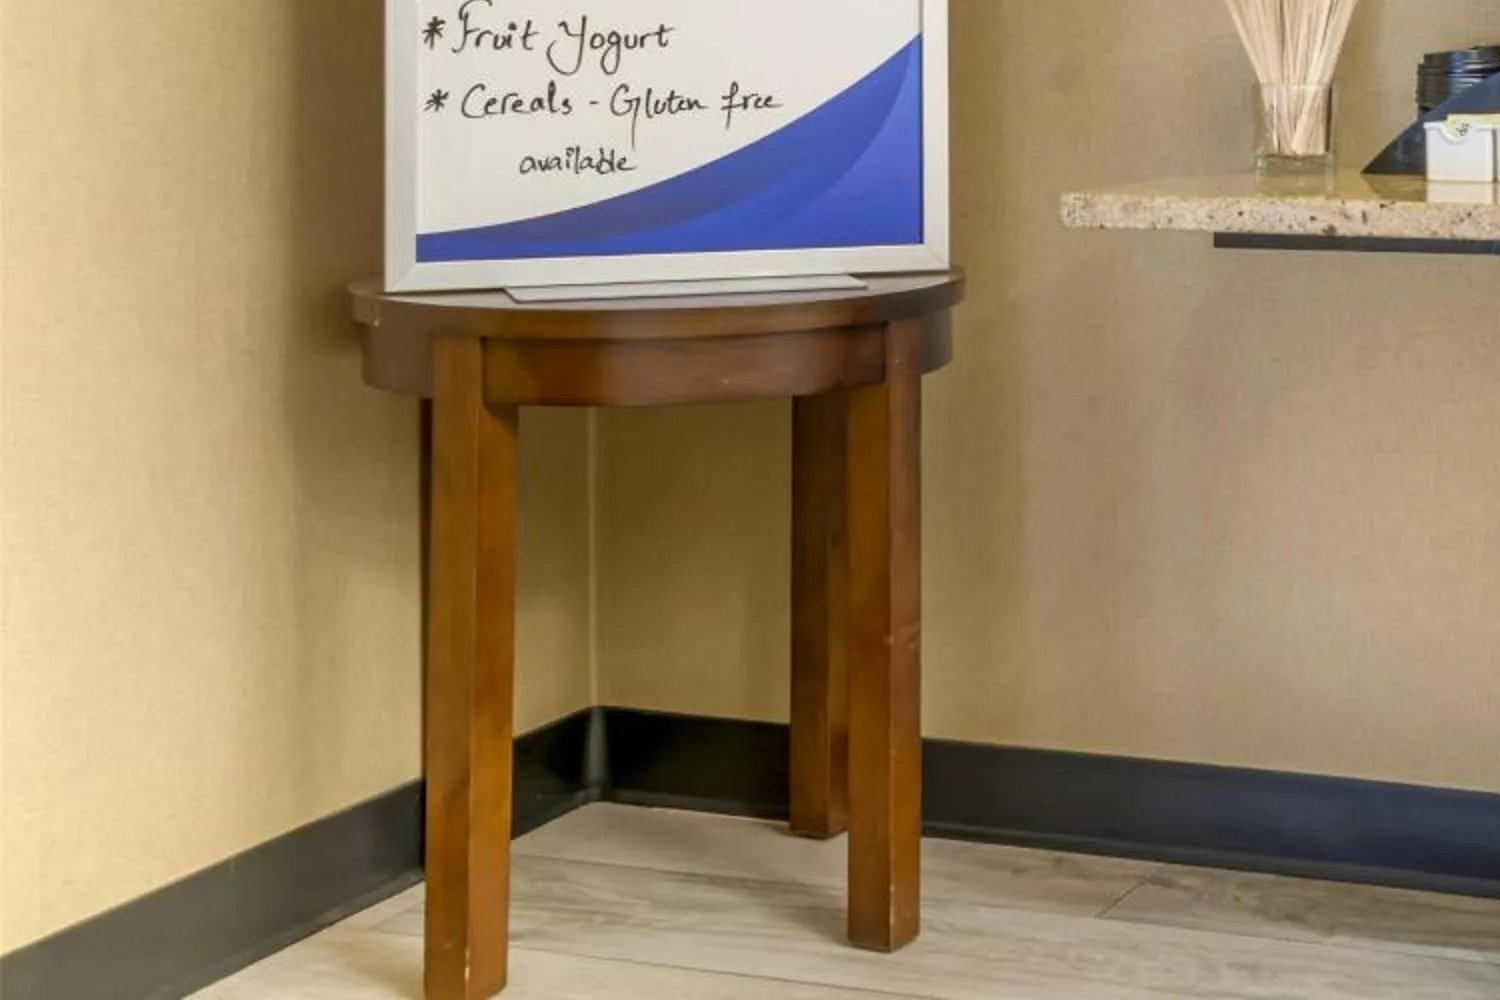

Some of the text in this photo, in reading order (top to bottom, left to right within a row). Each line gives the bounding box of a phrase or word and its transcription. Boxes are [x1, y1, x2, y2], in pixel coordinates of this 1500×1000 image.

[546, 14, 675, 76] Yogurt
[460, 80, 573, 119] Cereals
[609, 83, 709, 150] Gluten
[720, 81, 784, 129] free
[518, 145, 637, 176] available
